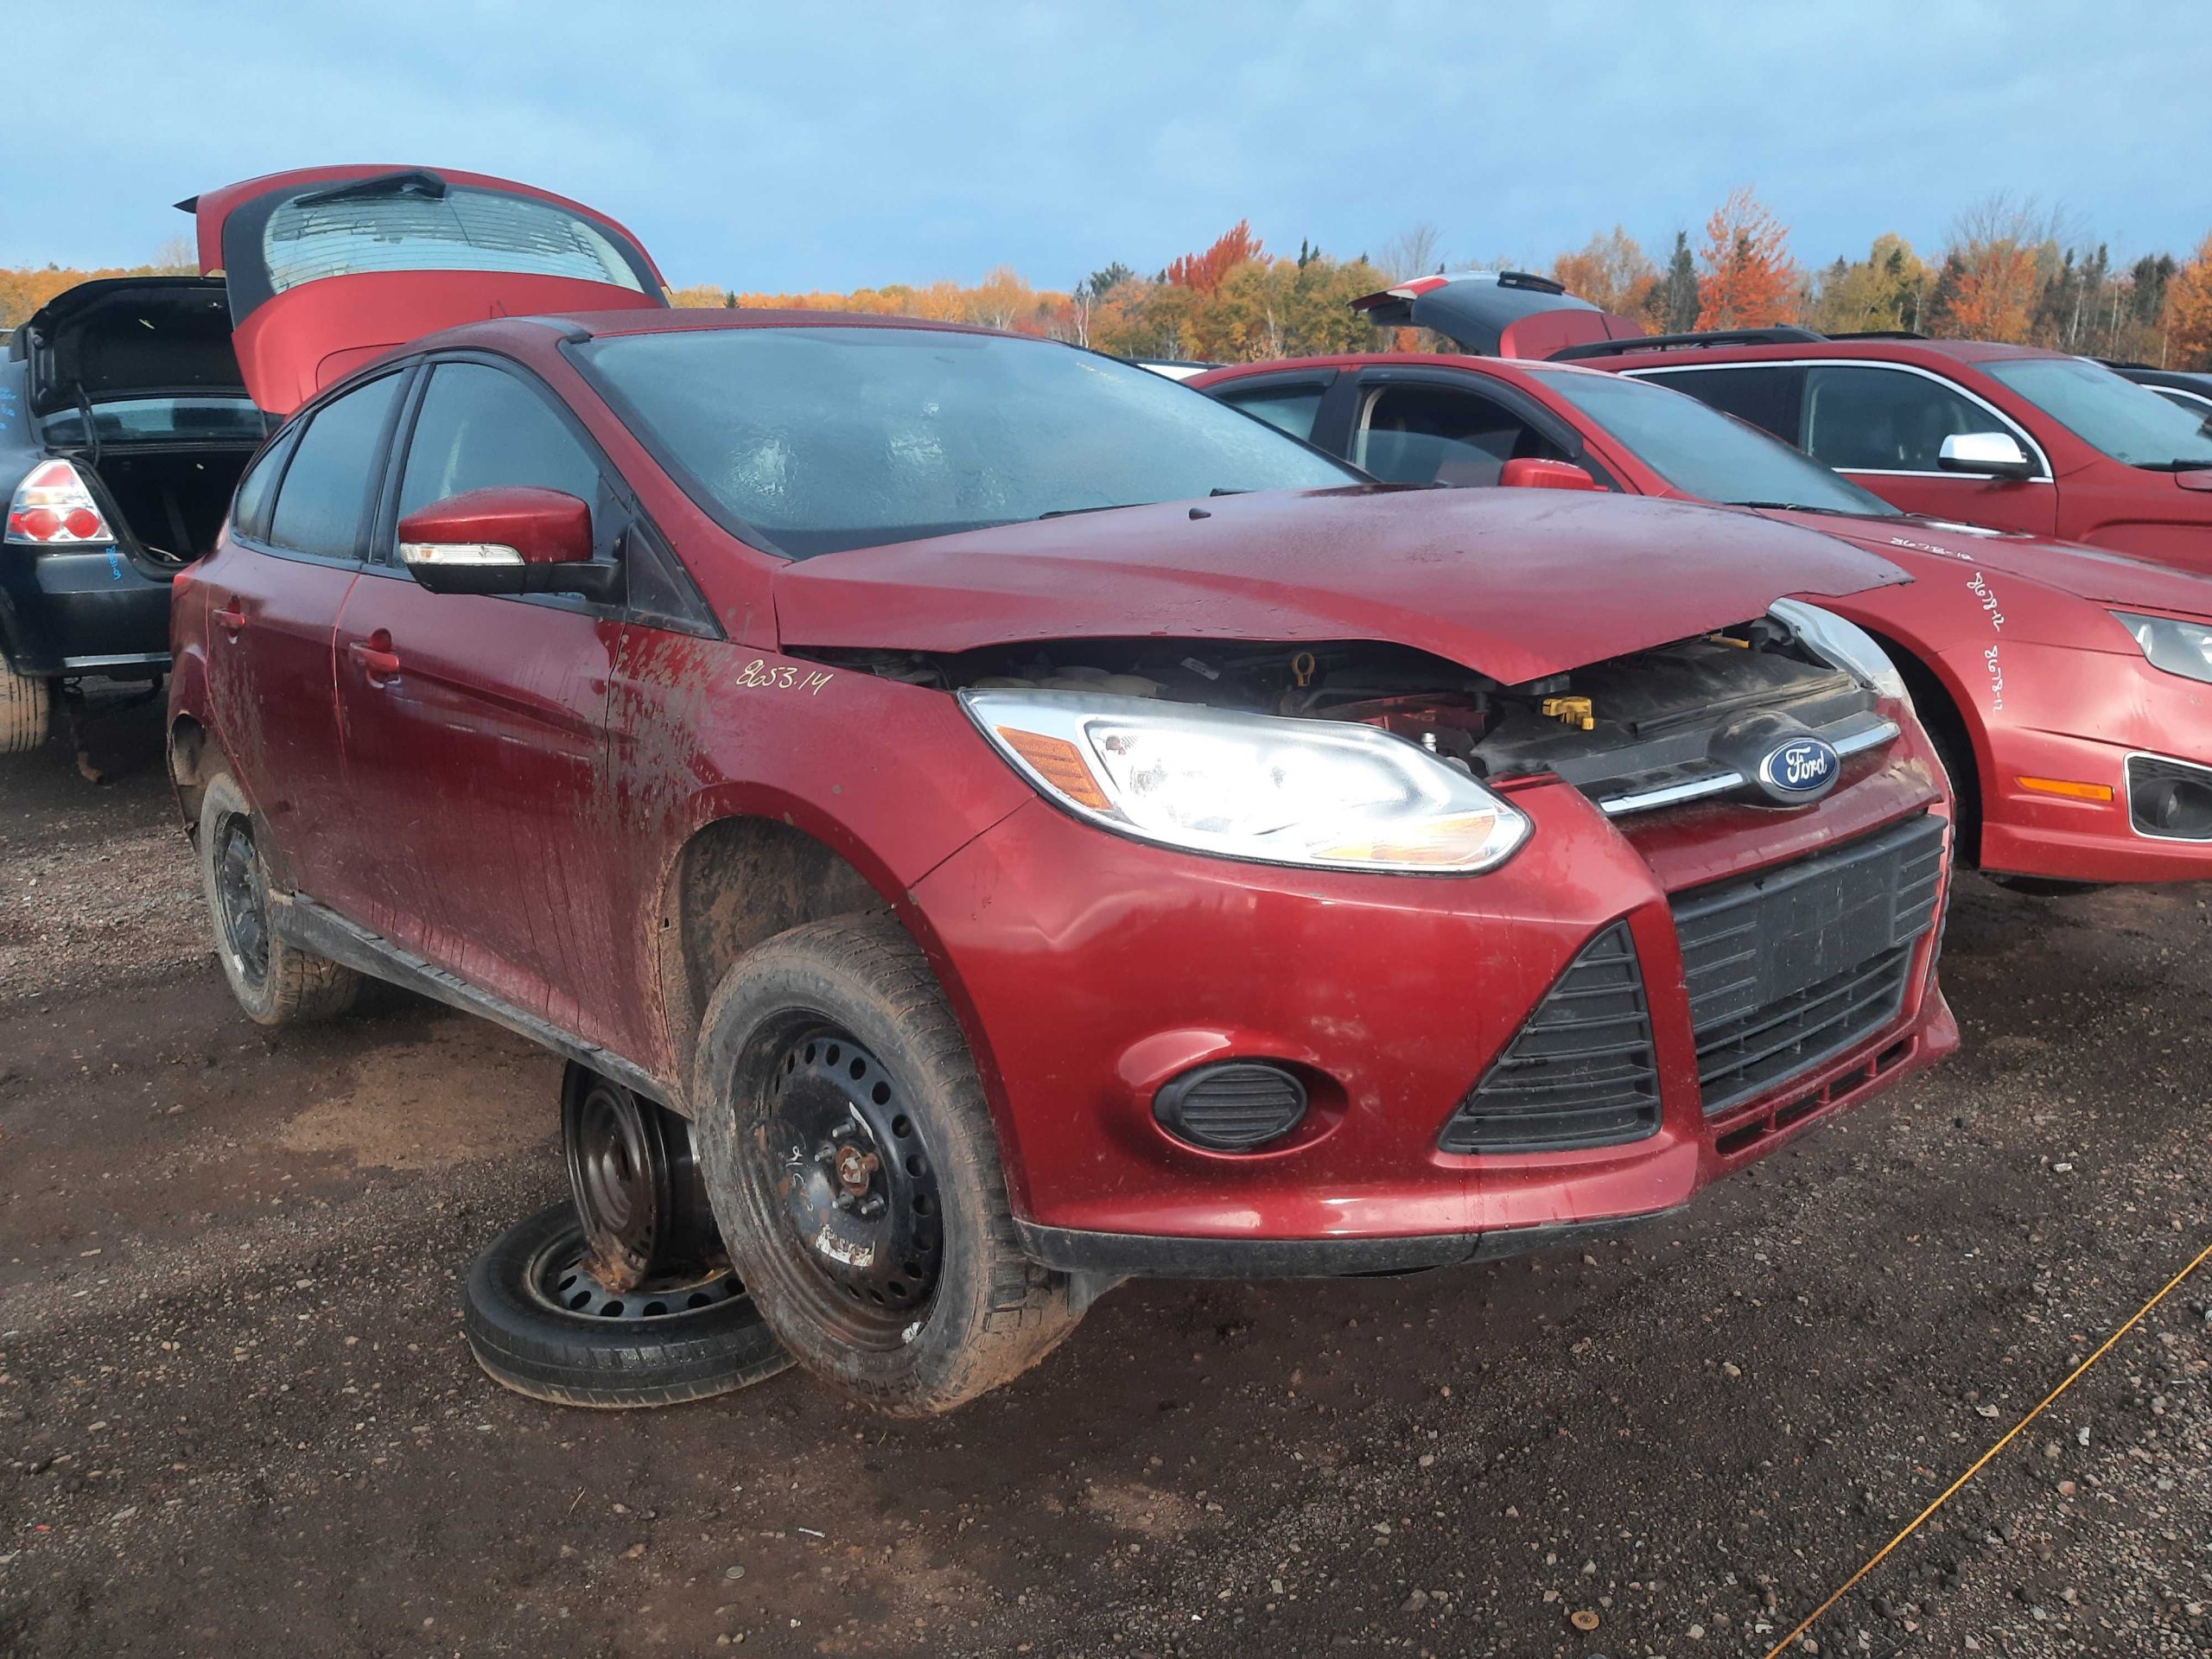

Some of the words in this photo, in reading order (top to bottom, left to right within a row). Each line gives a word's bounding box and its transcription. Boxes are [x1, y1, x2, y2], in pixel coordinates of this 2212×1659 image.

[1967, 571, 2005, 632] 8678-12
[1985, 645, 2003, 715] 8678-12
[1785, 746, 1827, 784] Ford
